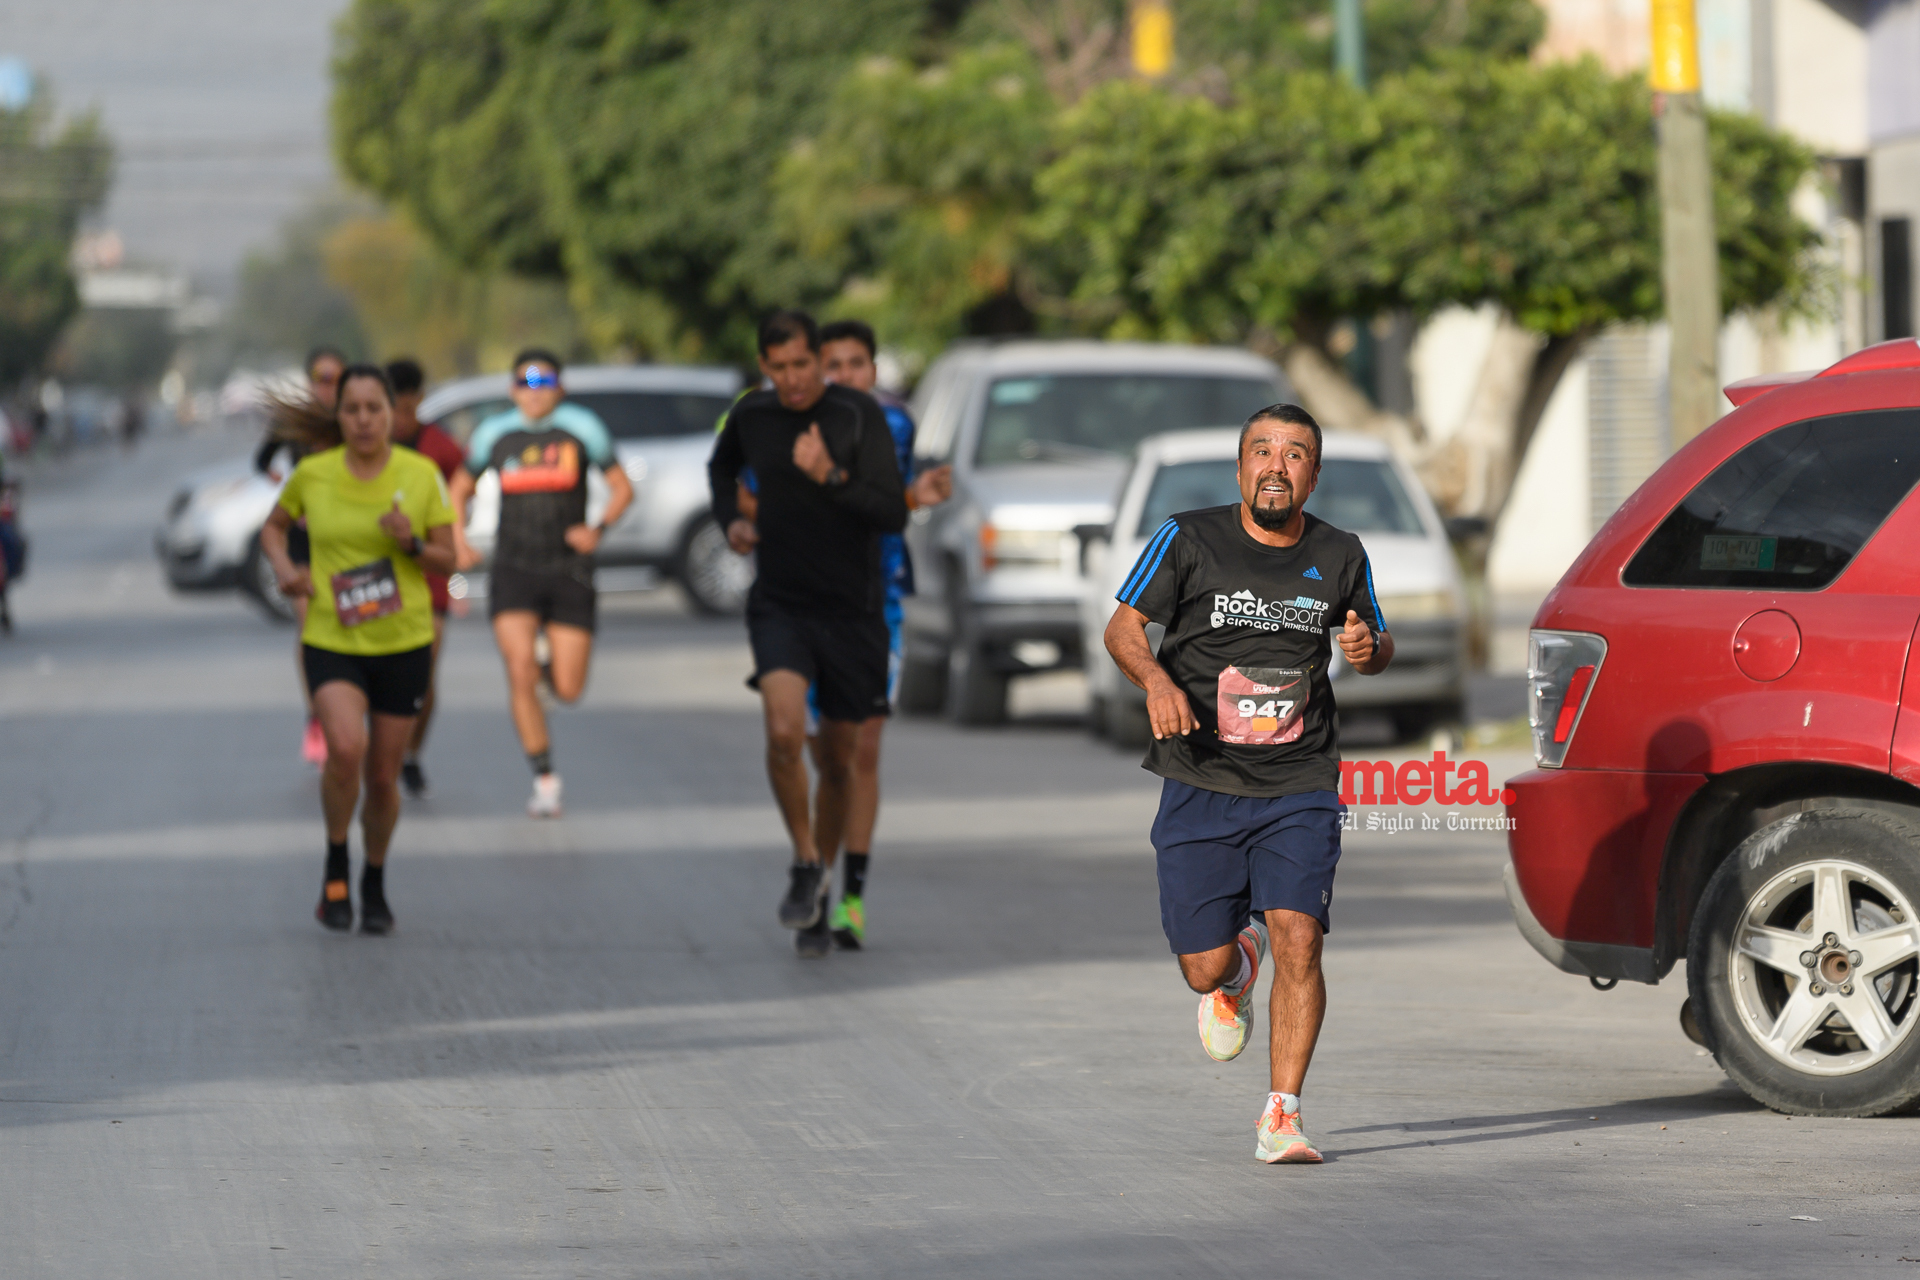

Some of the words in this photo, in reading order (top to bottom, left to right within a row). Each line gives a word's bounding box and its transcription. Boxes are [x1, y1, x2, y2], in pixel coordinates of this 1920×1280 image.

[1294, 596, 1315, 609] RUN
[1284, 621, 1309, 632] FITNESS
[1237, 699, 1294, 719] 947
